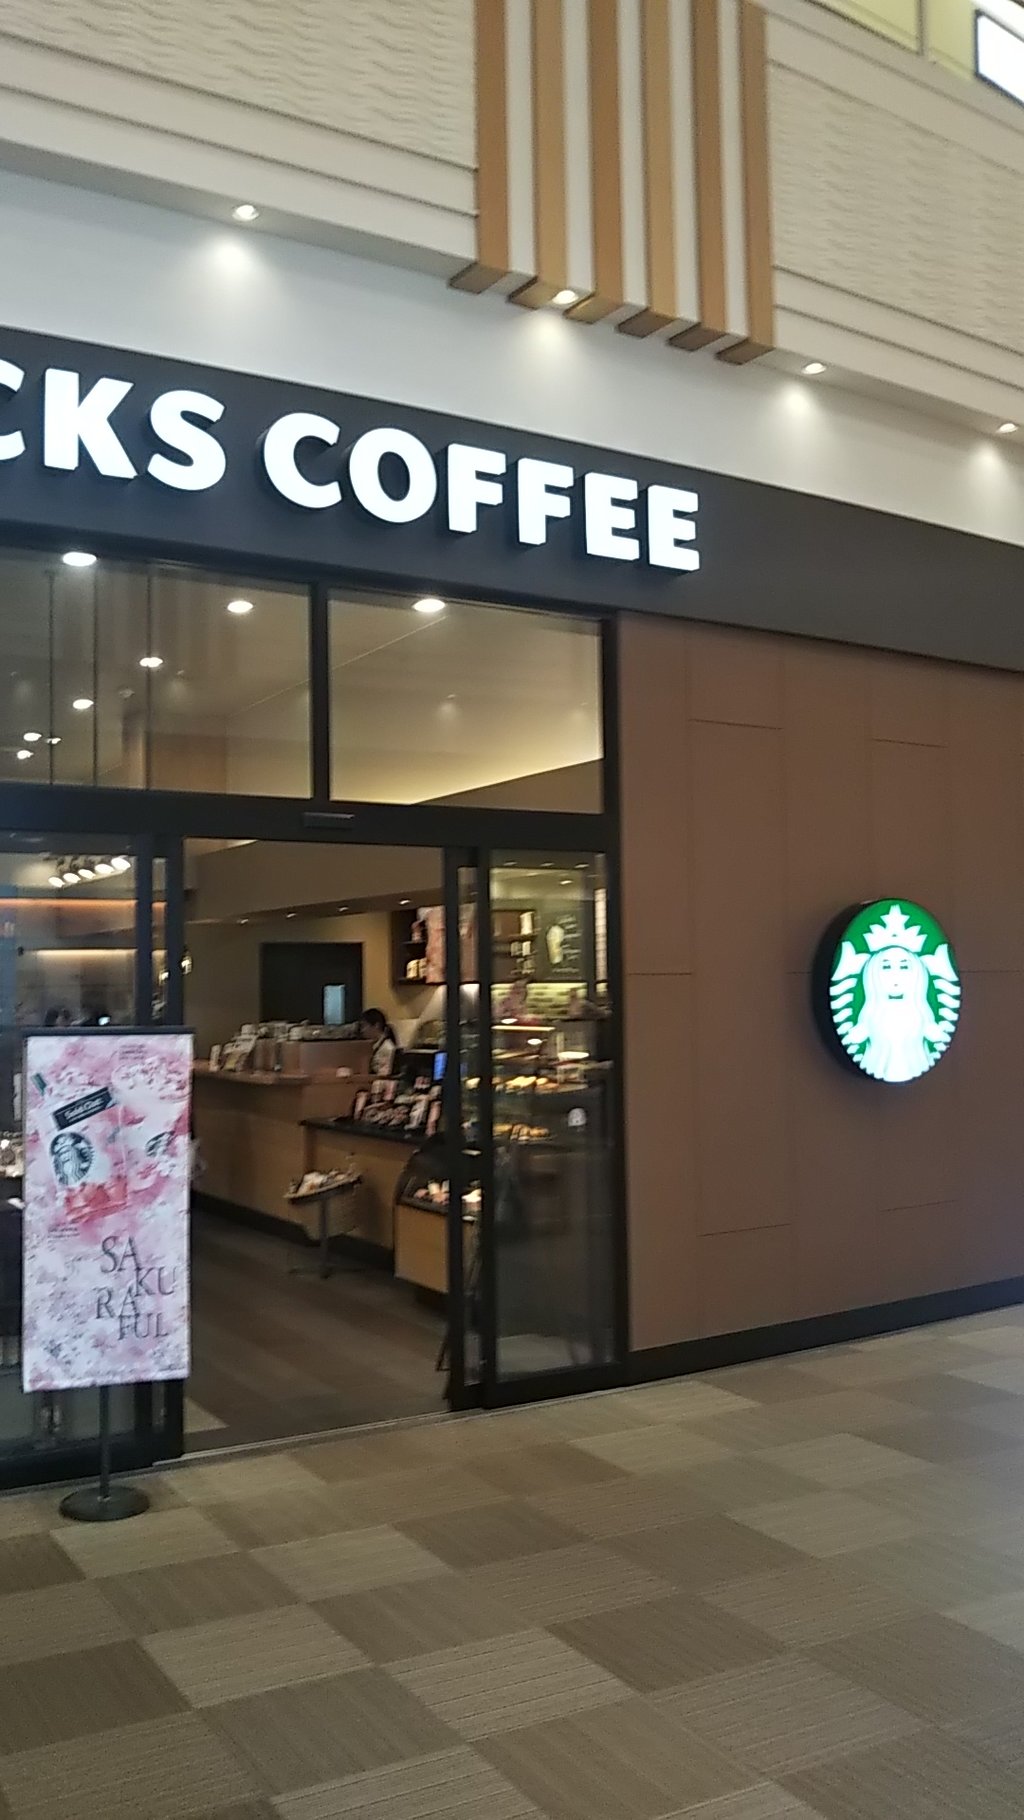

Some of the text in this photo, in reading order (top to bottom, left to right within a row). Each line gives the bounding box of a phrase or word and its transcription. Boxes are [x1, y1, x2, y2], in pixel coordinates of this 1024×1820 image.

[263, 411, 701, 572] COFFEE
[101, 1235, 140, 1273] SA
[134, 1266, 177, 1297] KU
[92, 1286, 138, 1319] RA
[117, 1312, 170, 1341] FUL
